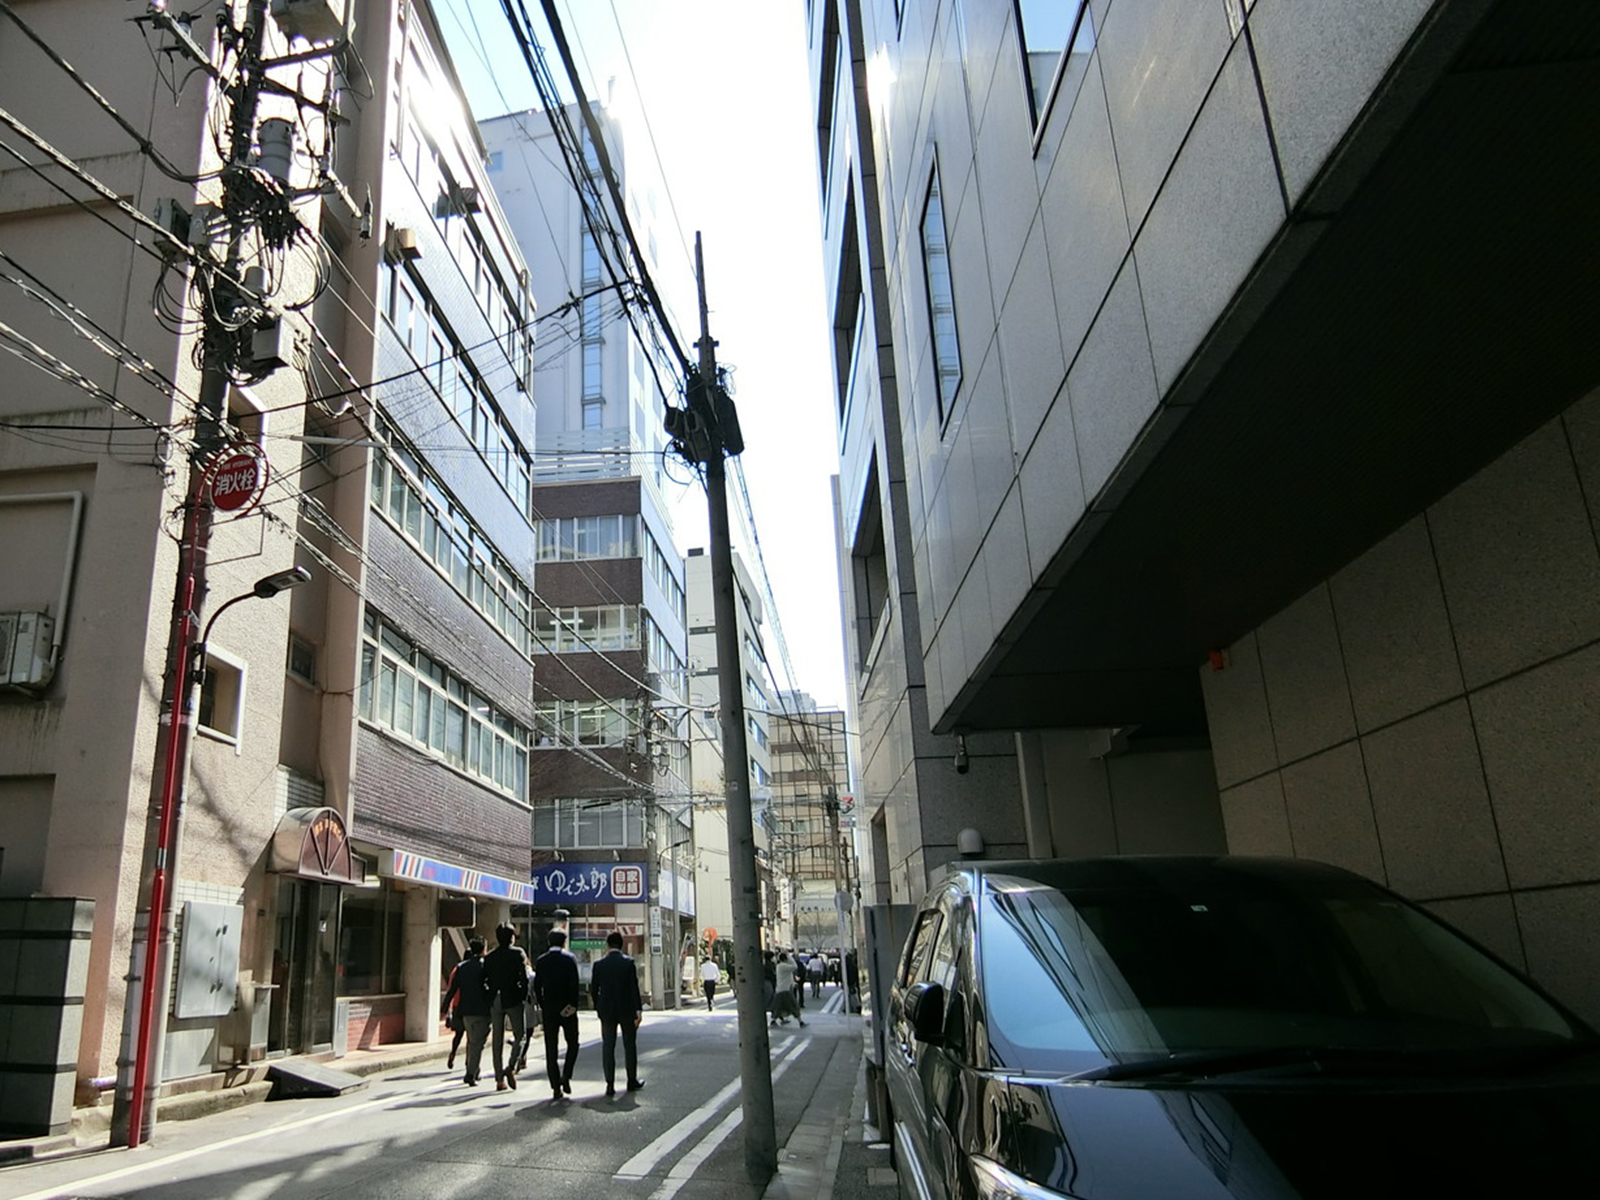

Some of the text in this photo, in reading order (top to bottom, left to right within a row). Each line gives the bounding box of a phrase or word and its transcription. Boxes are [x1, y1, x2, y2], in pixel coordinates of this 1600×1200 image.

[214, 468, 256, 496] 消火栓
[544, 867, 607, 898] ゆで太郎
